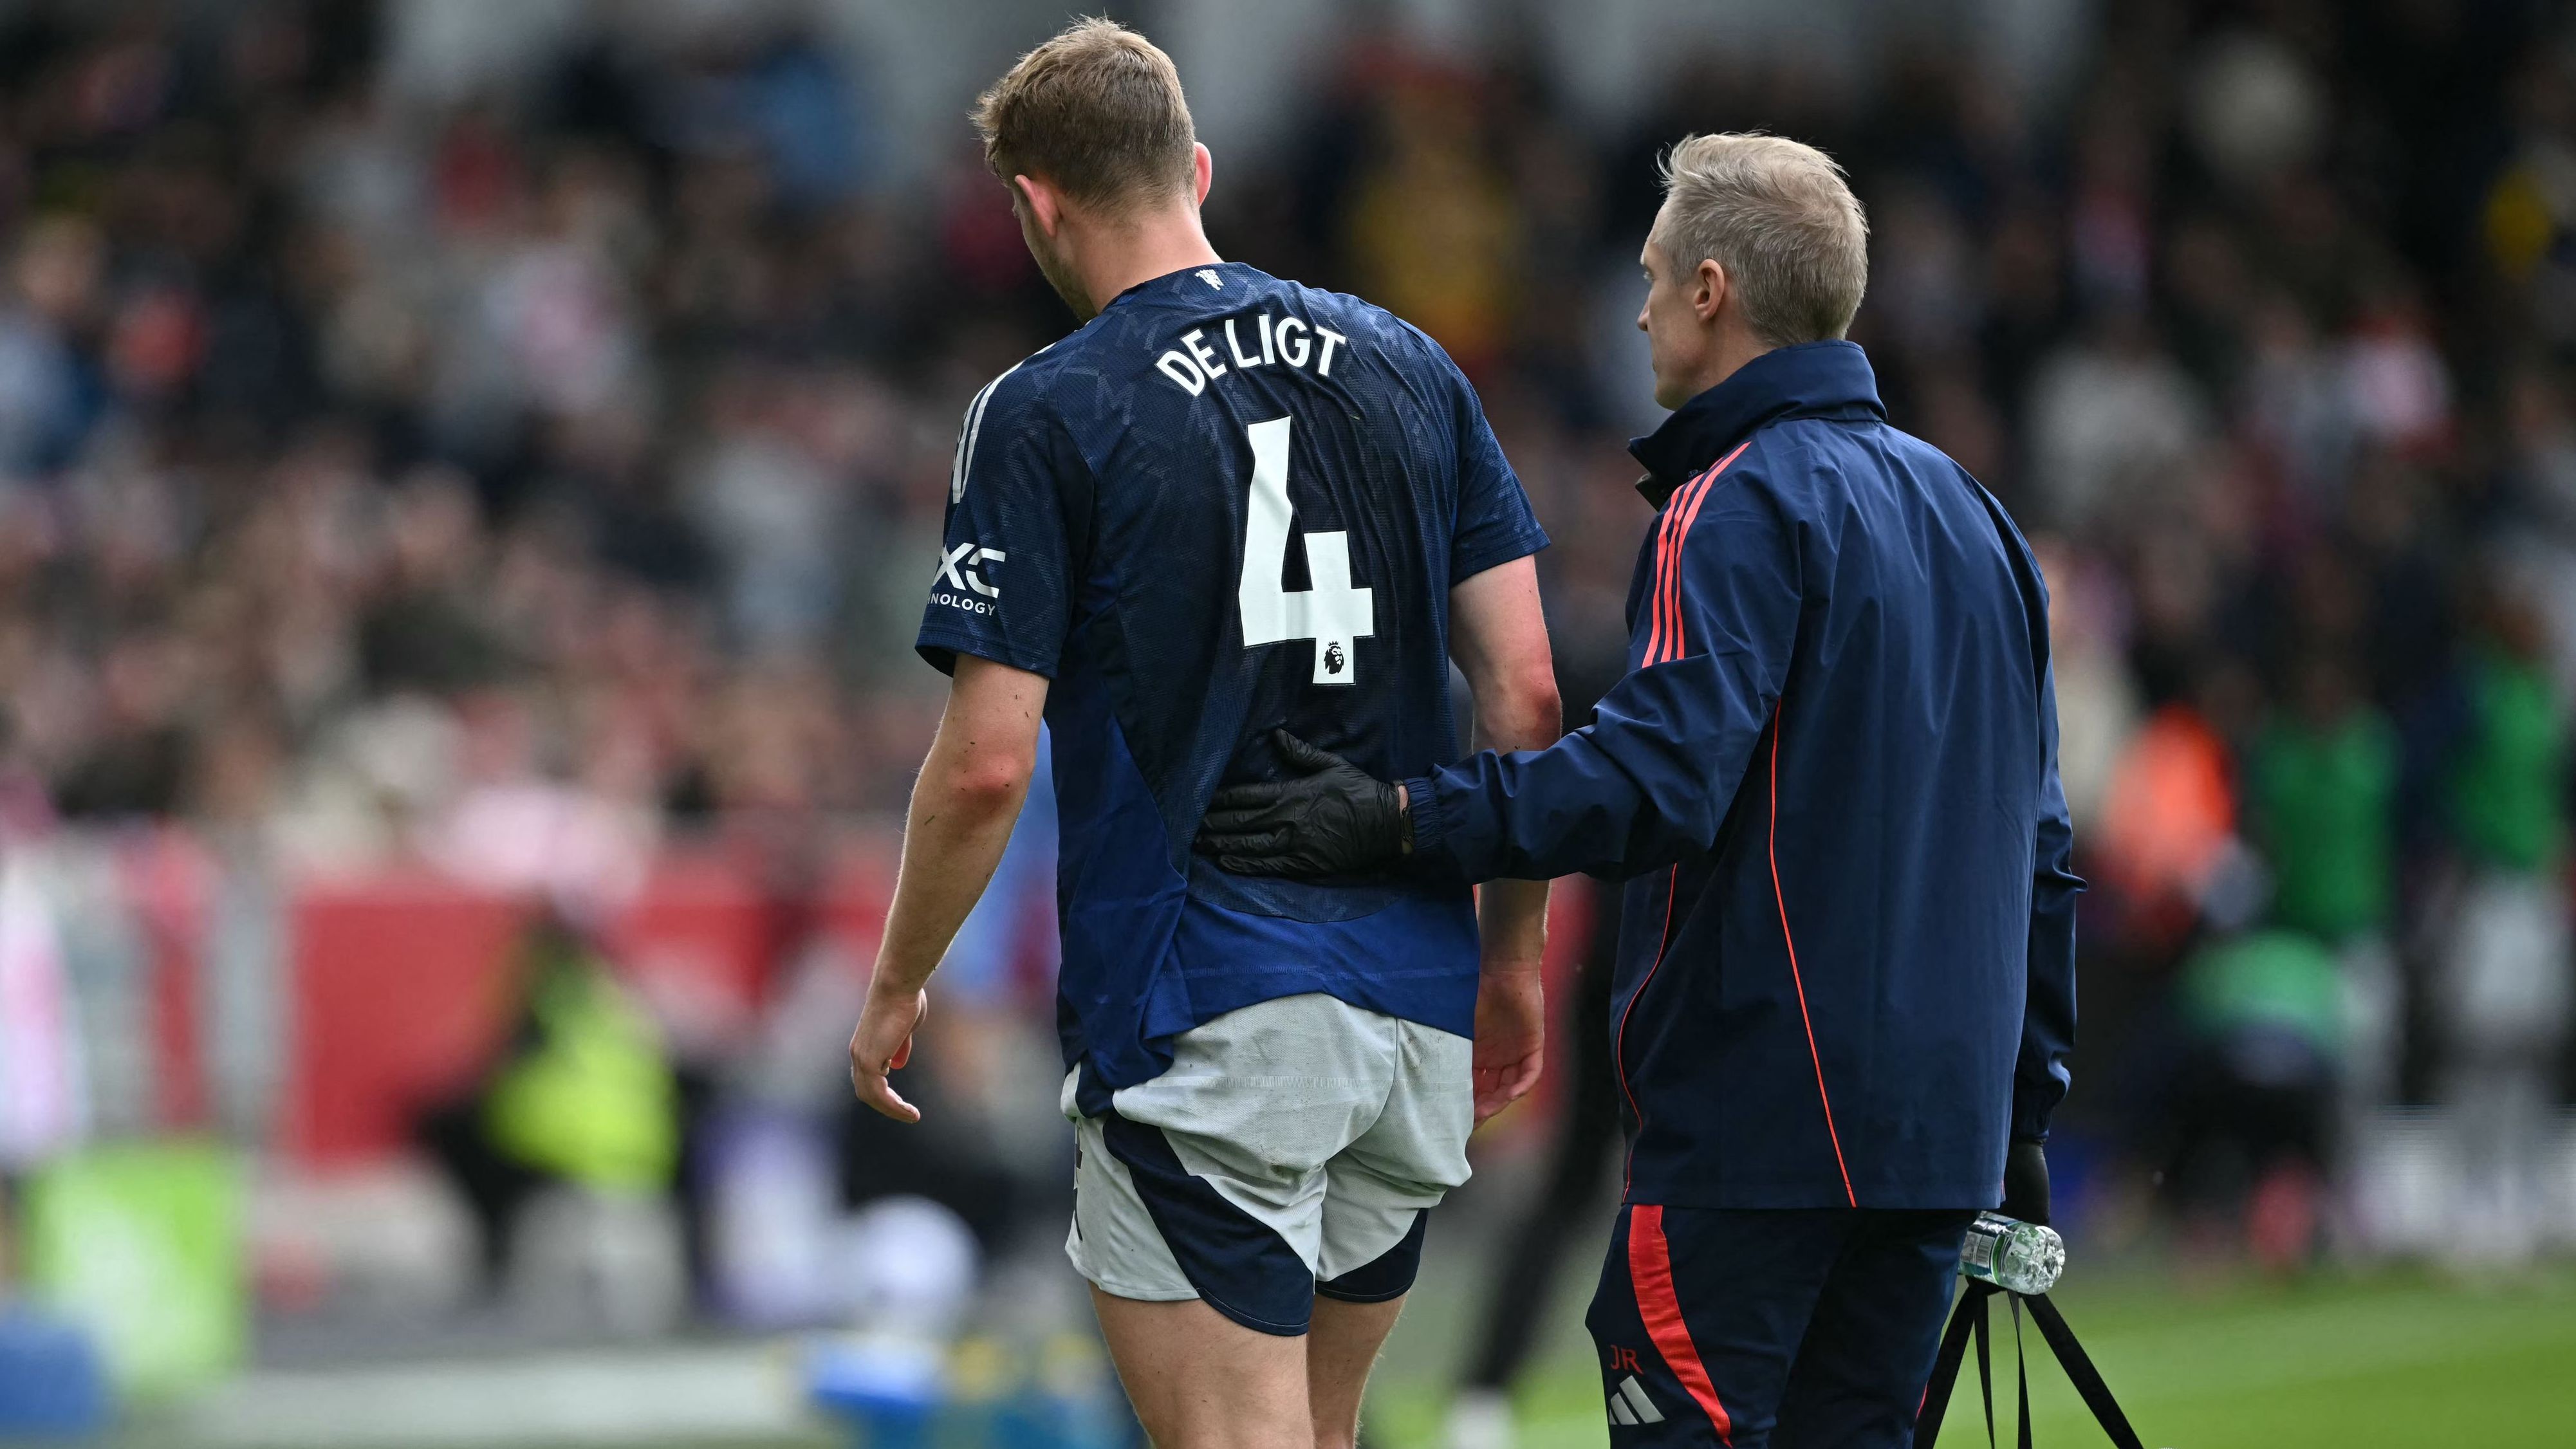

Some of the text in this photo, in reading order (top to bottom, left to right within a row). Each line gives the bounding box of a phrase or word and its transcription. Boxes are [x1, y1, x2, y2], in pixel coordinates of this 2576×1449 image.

[1155, 314, 1348, 398] DE LIGT
[1238, 415, 1375, 685] 4
[928, 593, 996, 616] NOLOGY
[1610, 1344, 1644, 1374] JR
